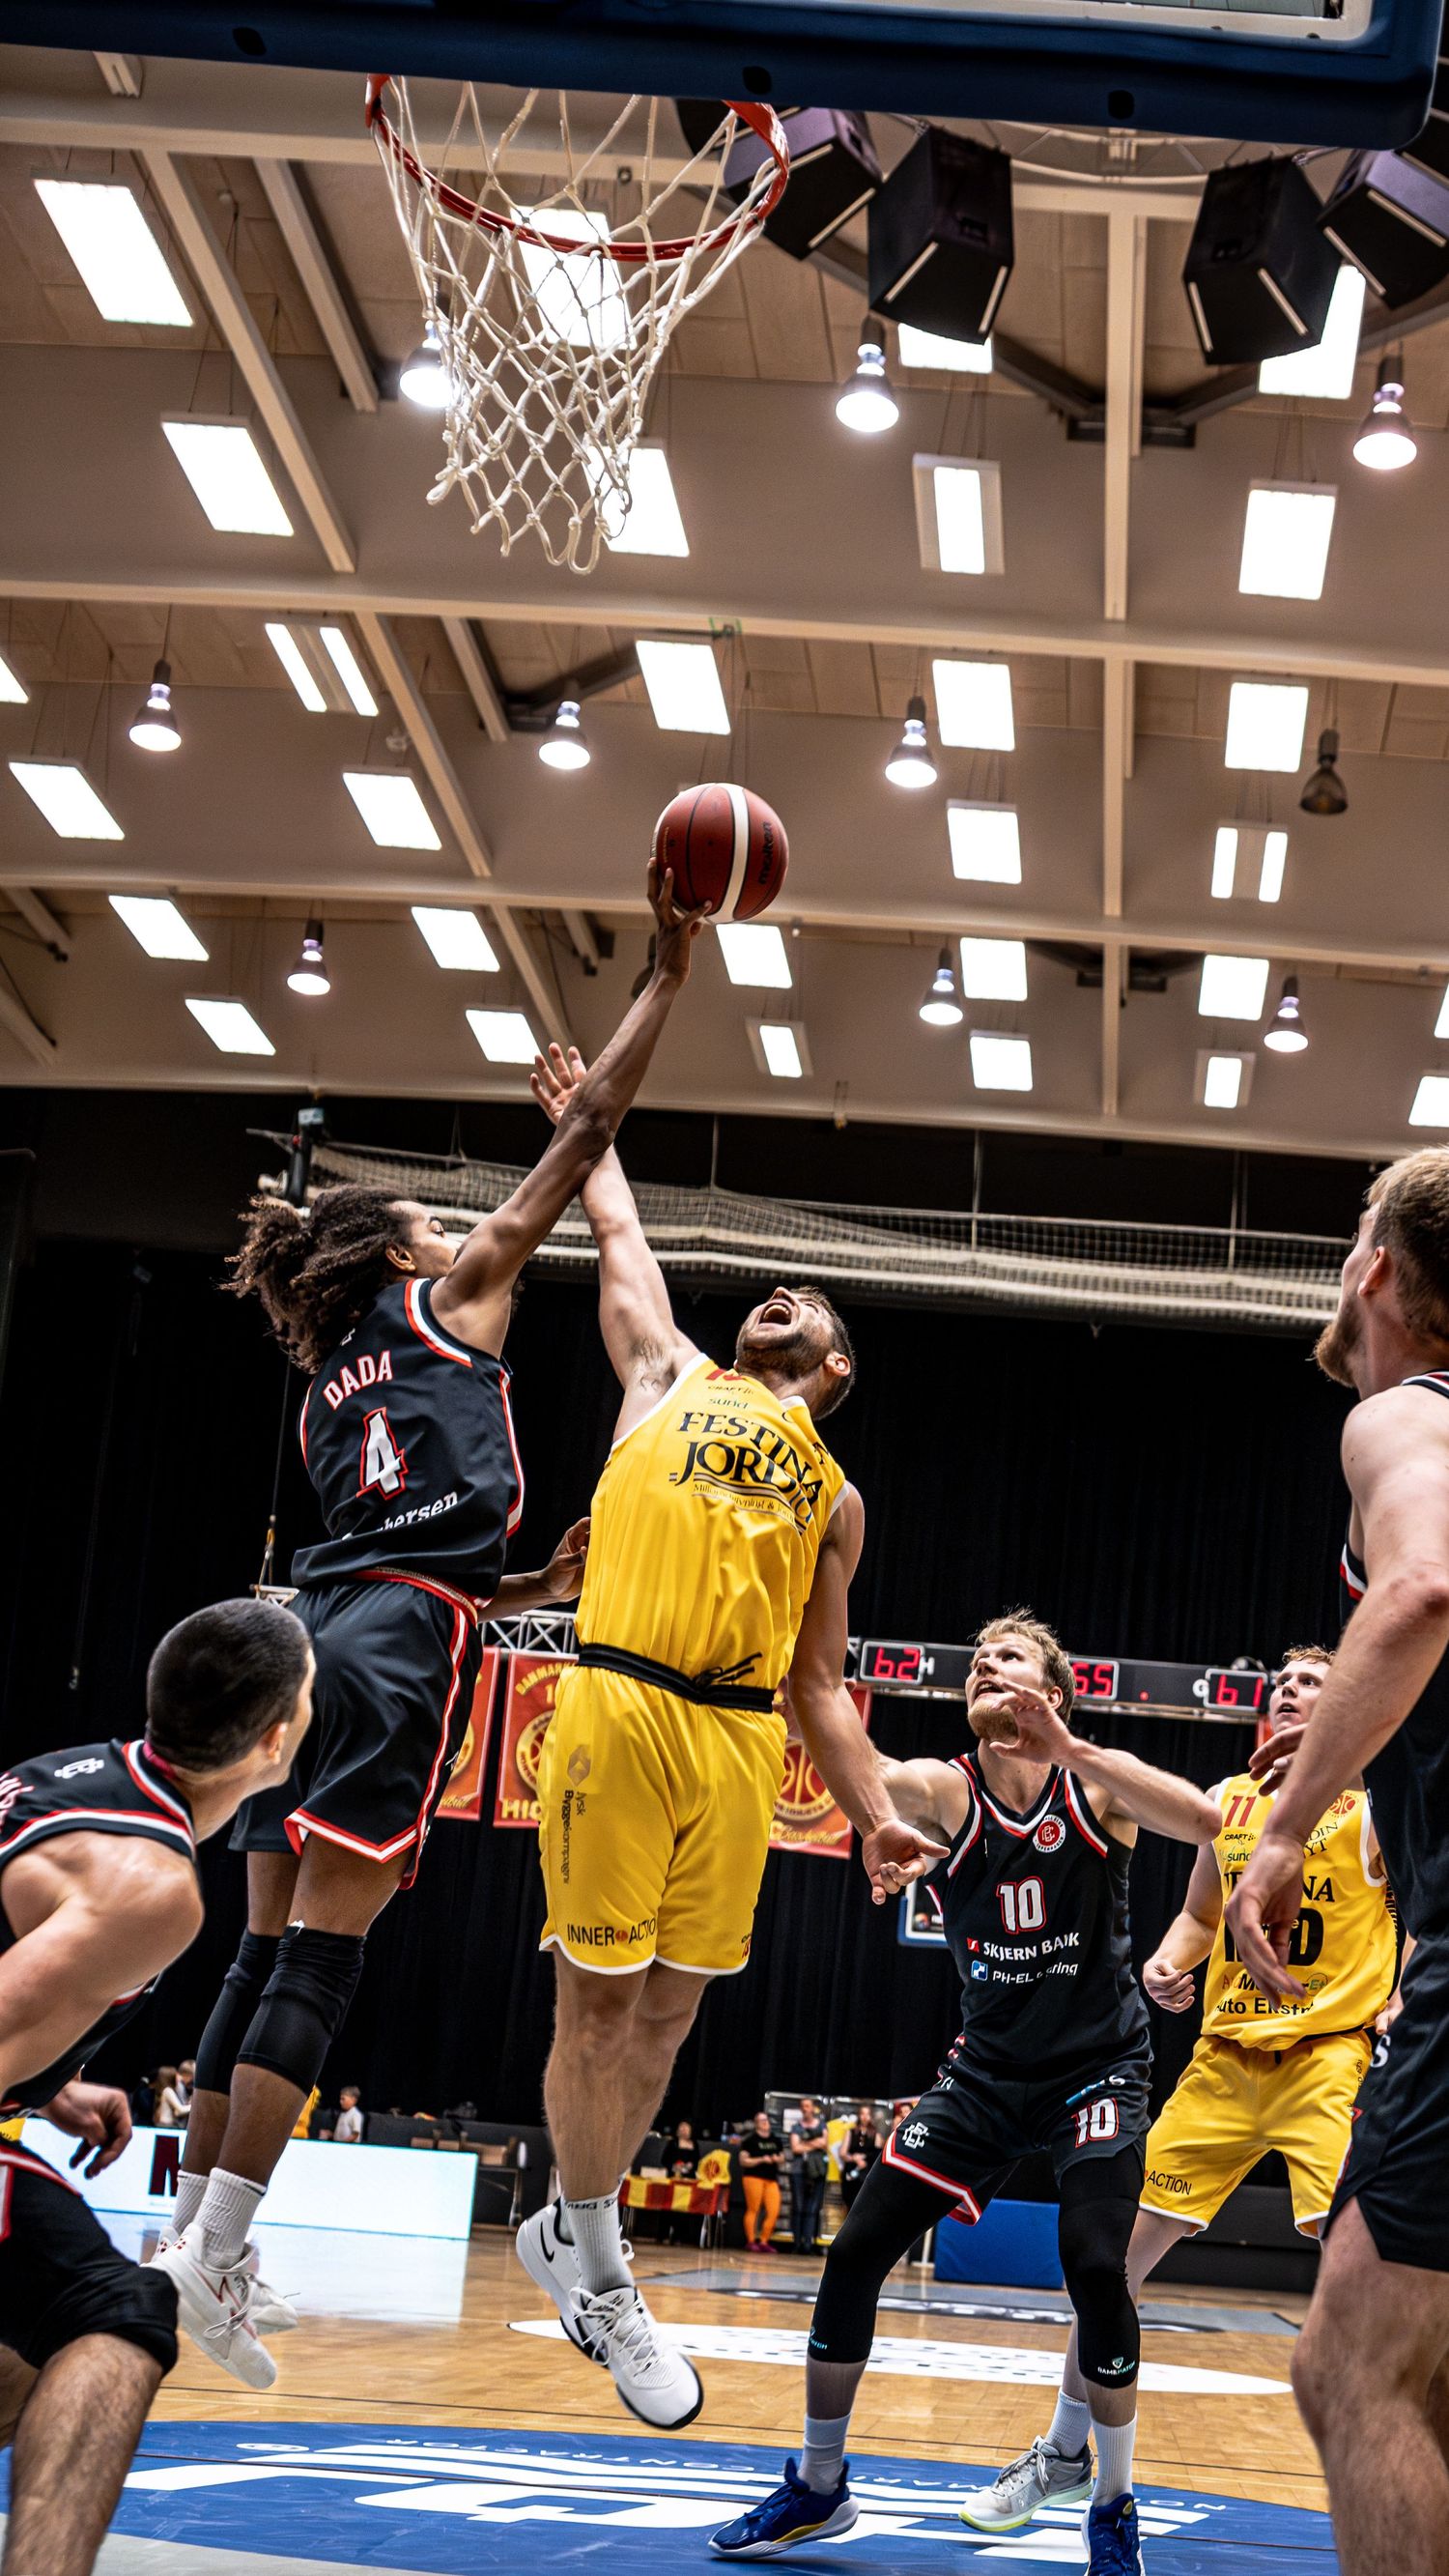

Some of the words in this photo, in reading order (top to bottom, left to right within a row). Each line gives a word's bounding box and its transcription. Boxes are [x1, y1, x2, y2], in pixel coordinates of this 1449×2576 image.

[323, 1350, 393, 1411] DADA
[356, 1407, 409, 1500] 4
[677, 1412, 823, 1506] FESTINA
[873, 1646, 921, 1680] 62
[1216, 1674, 1264, 1707] 61
[1224, 1795, 1257, 1828] 11
[1304, 1838, 1327, 1857] YT
[1308, 1821, 1338, 1841] DIN
[997, 1876, 1047, 1934] 10
[567, 1924, 615, 1946] INNER
[629, 1918, 656, 1944] ACTIO
[983, 1941, 1037, 1961] SKJERN
[992, 1968, 1035, 1985] PH-EL
[1254, 1997, 1314, 2016] Estr
[1071, 2096, 1119, 2148] 10
[1147, 2170, 1192, 2196] ACTION
[386, 2438, 755, 2473] CONTRACTOR
